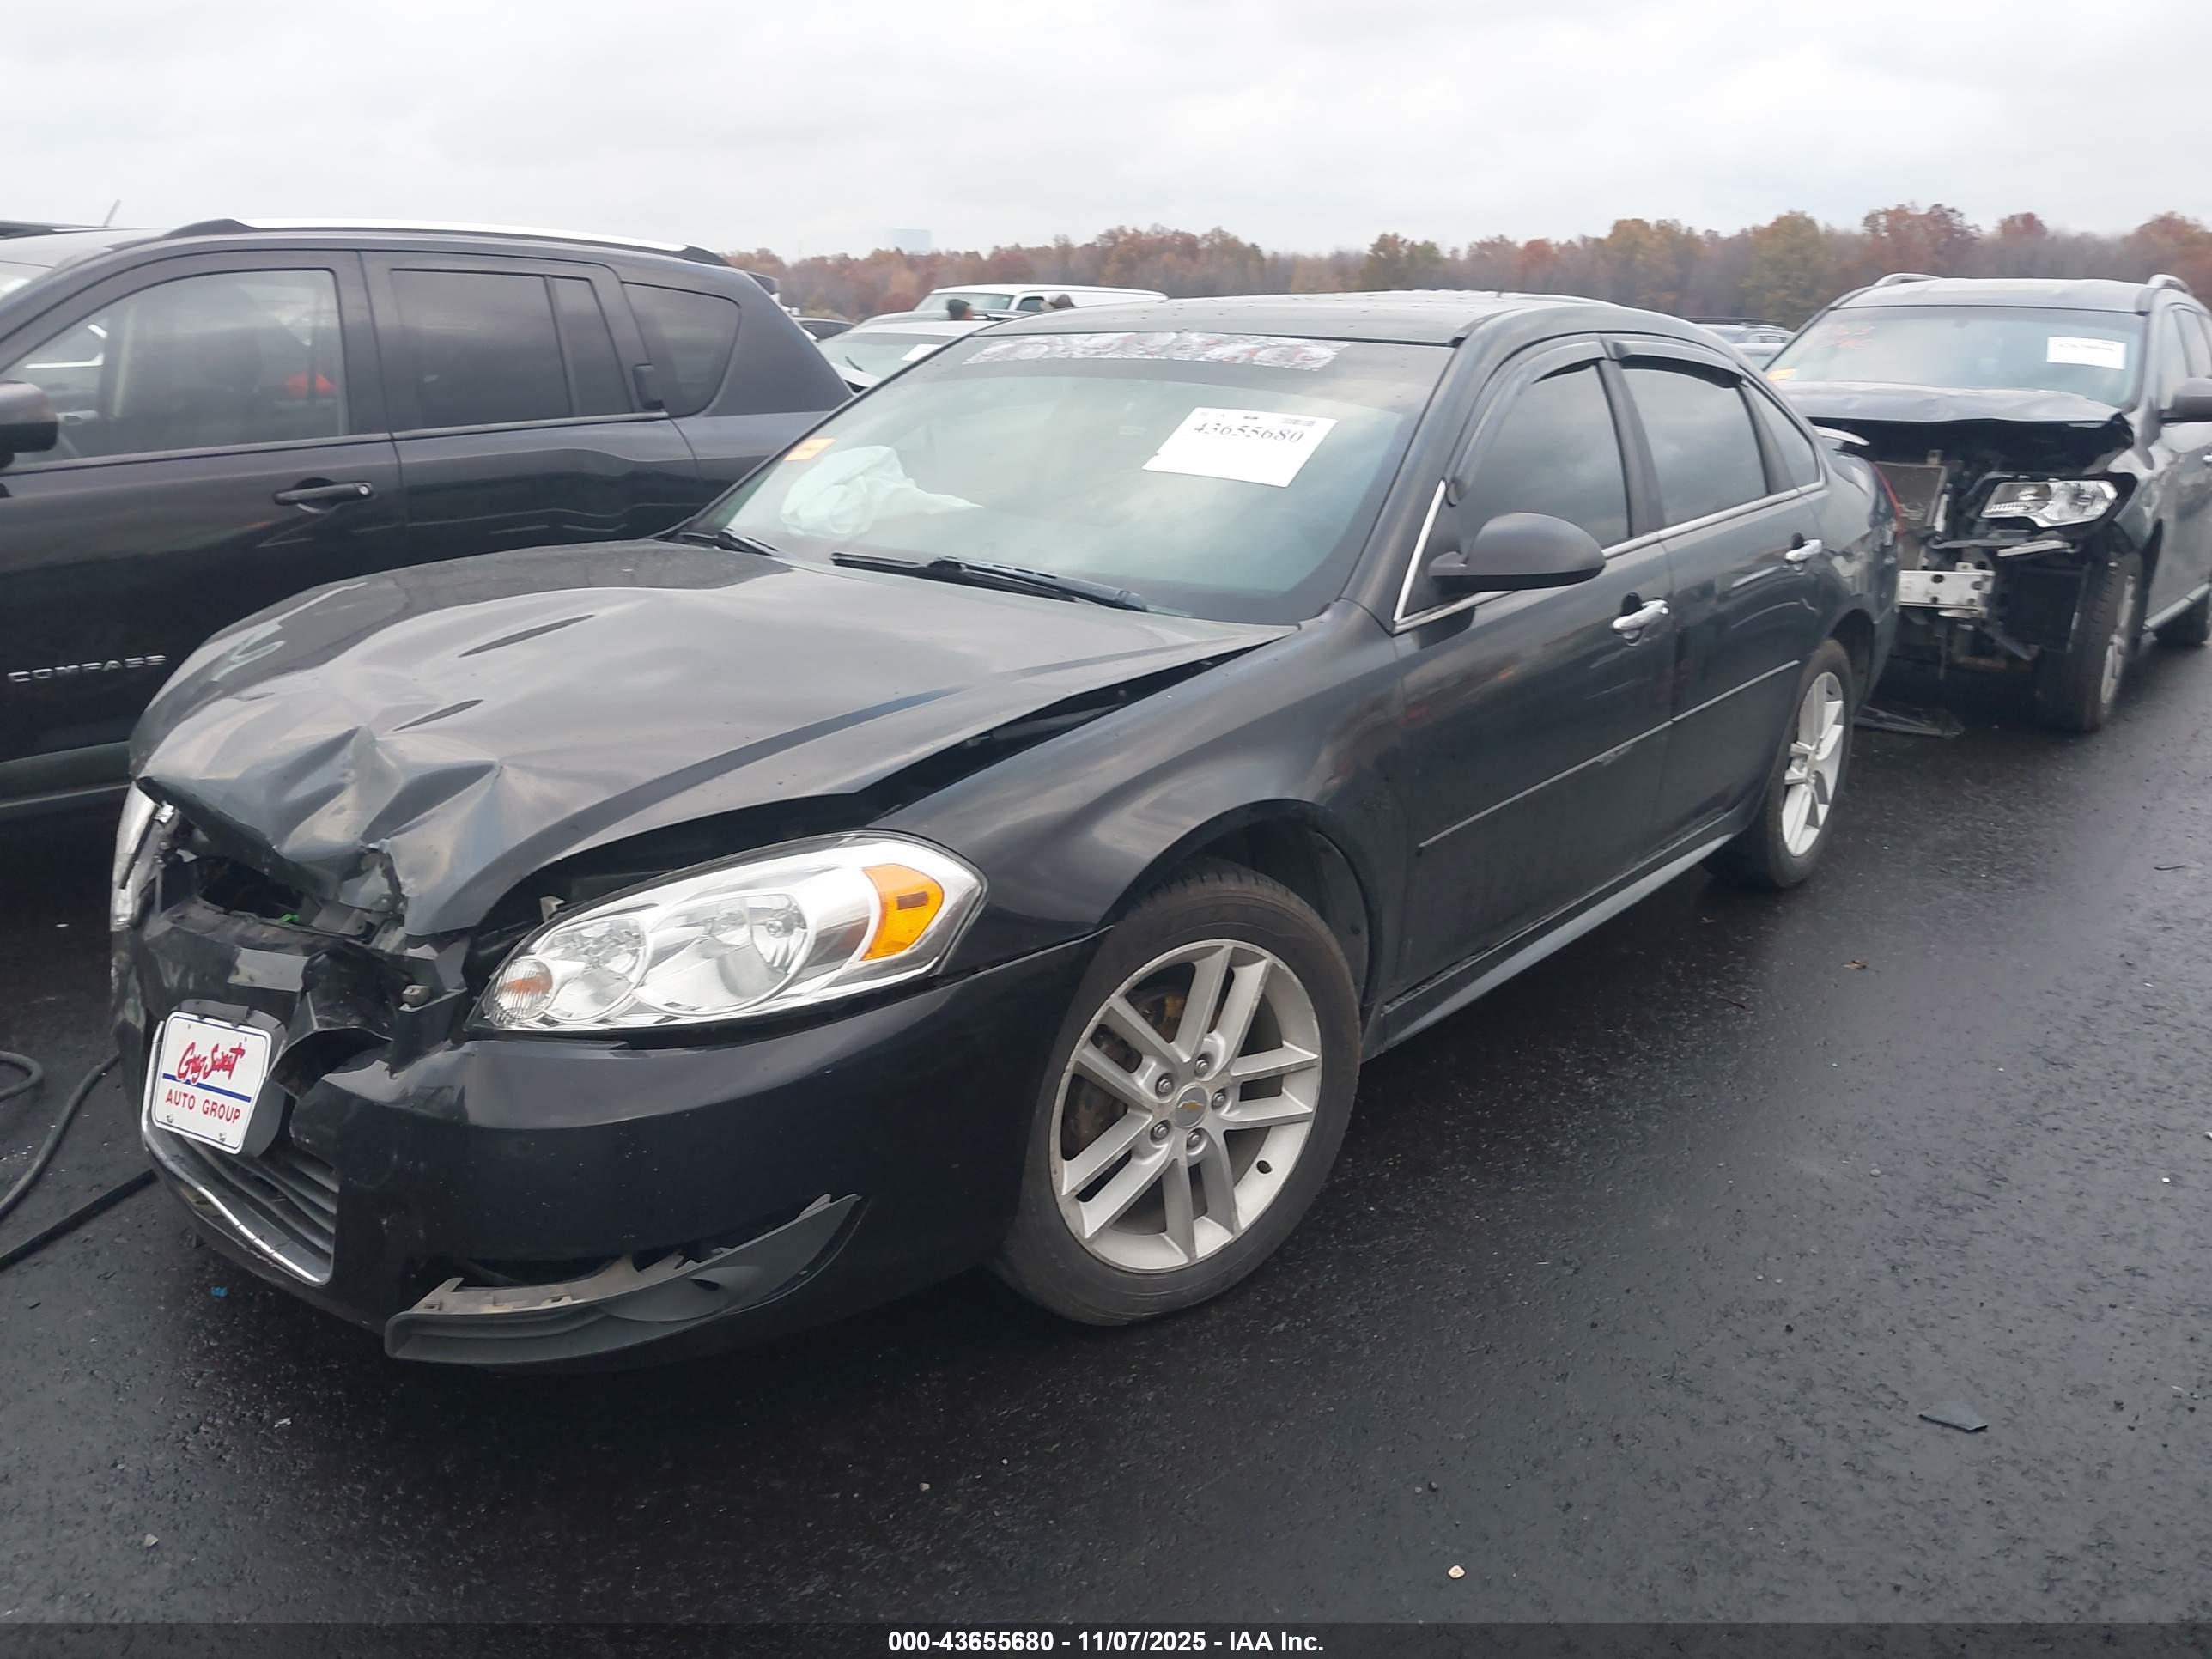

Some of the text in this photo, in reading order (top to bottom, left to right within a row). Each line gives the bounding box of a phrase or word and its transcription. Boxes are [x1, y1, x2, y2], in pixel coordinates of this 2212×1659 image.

[7, 654, 166, 683] COMPASS
[165, 1088, 241, 1124] AUTO GROUP
